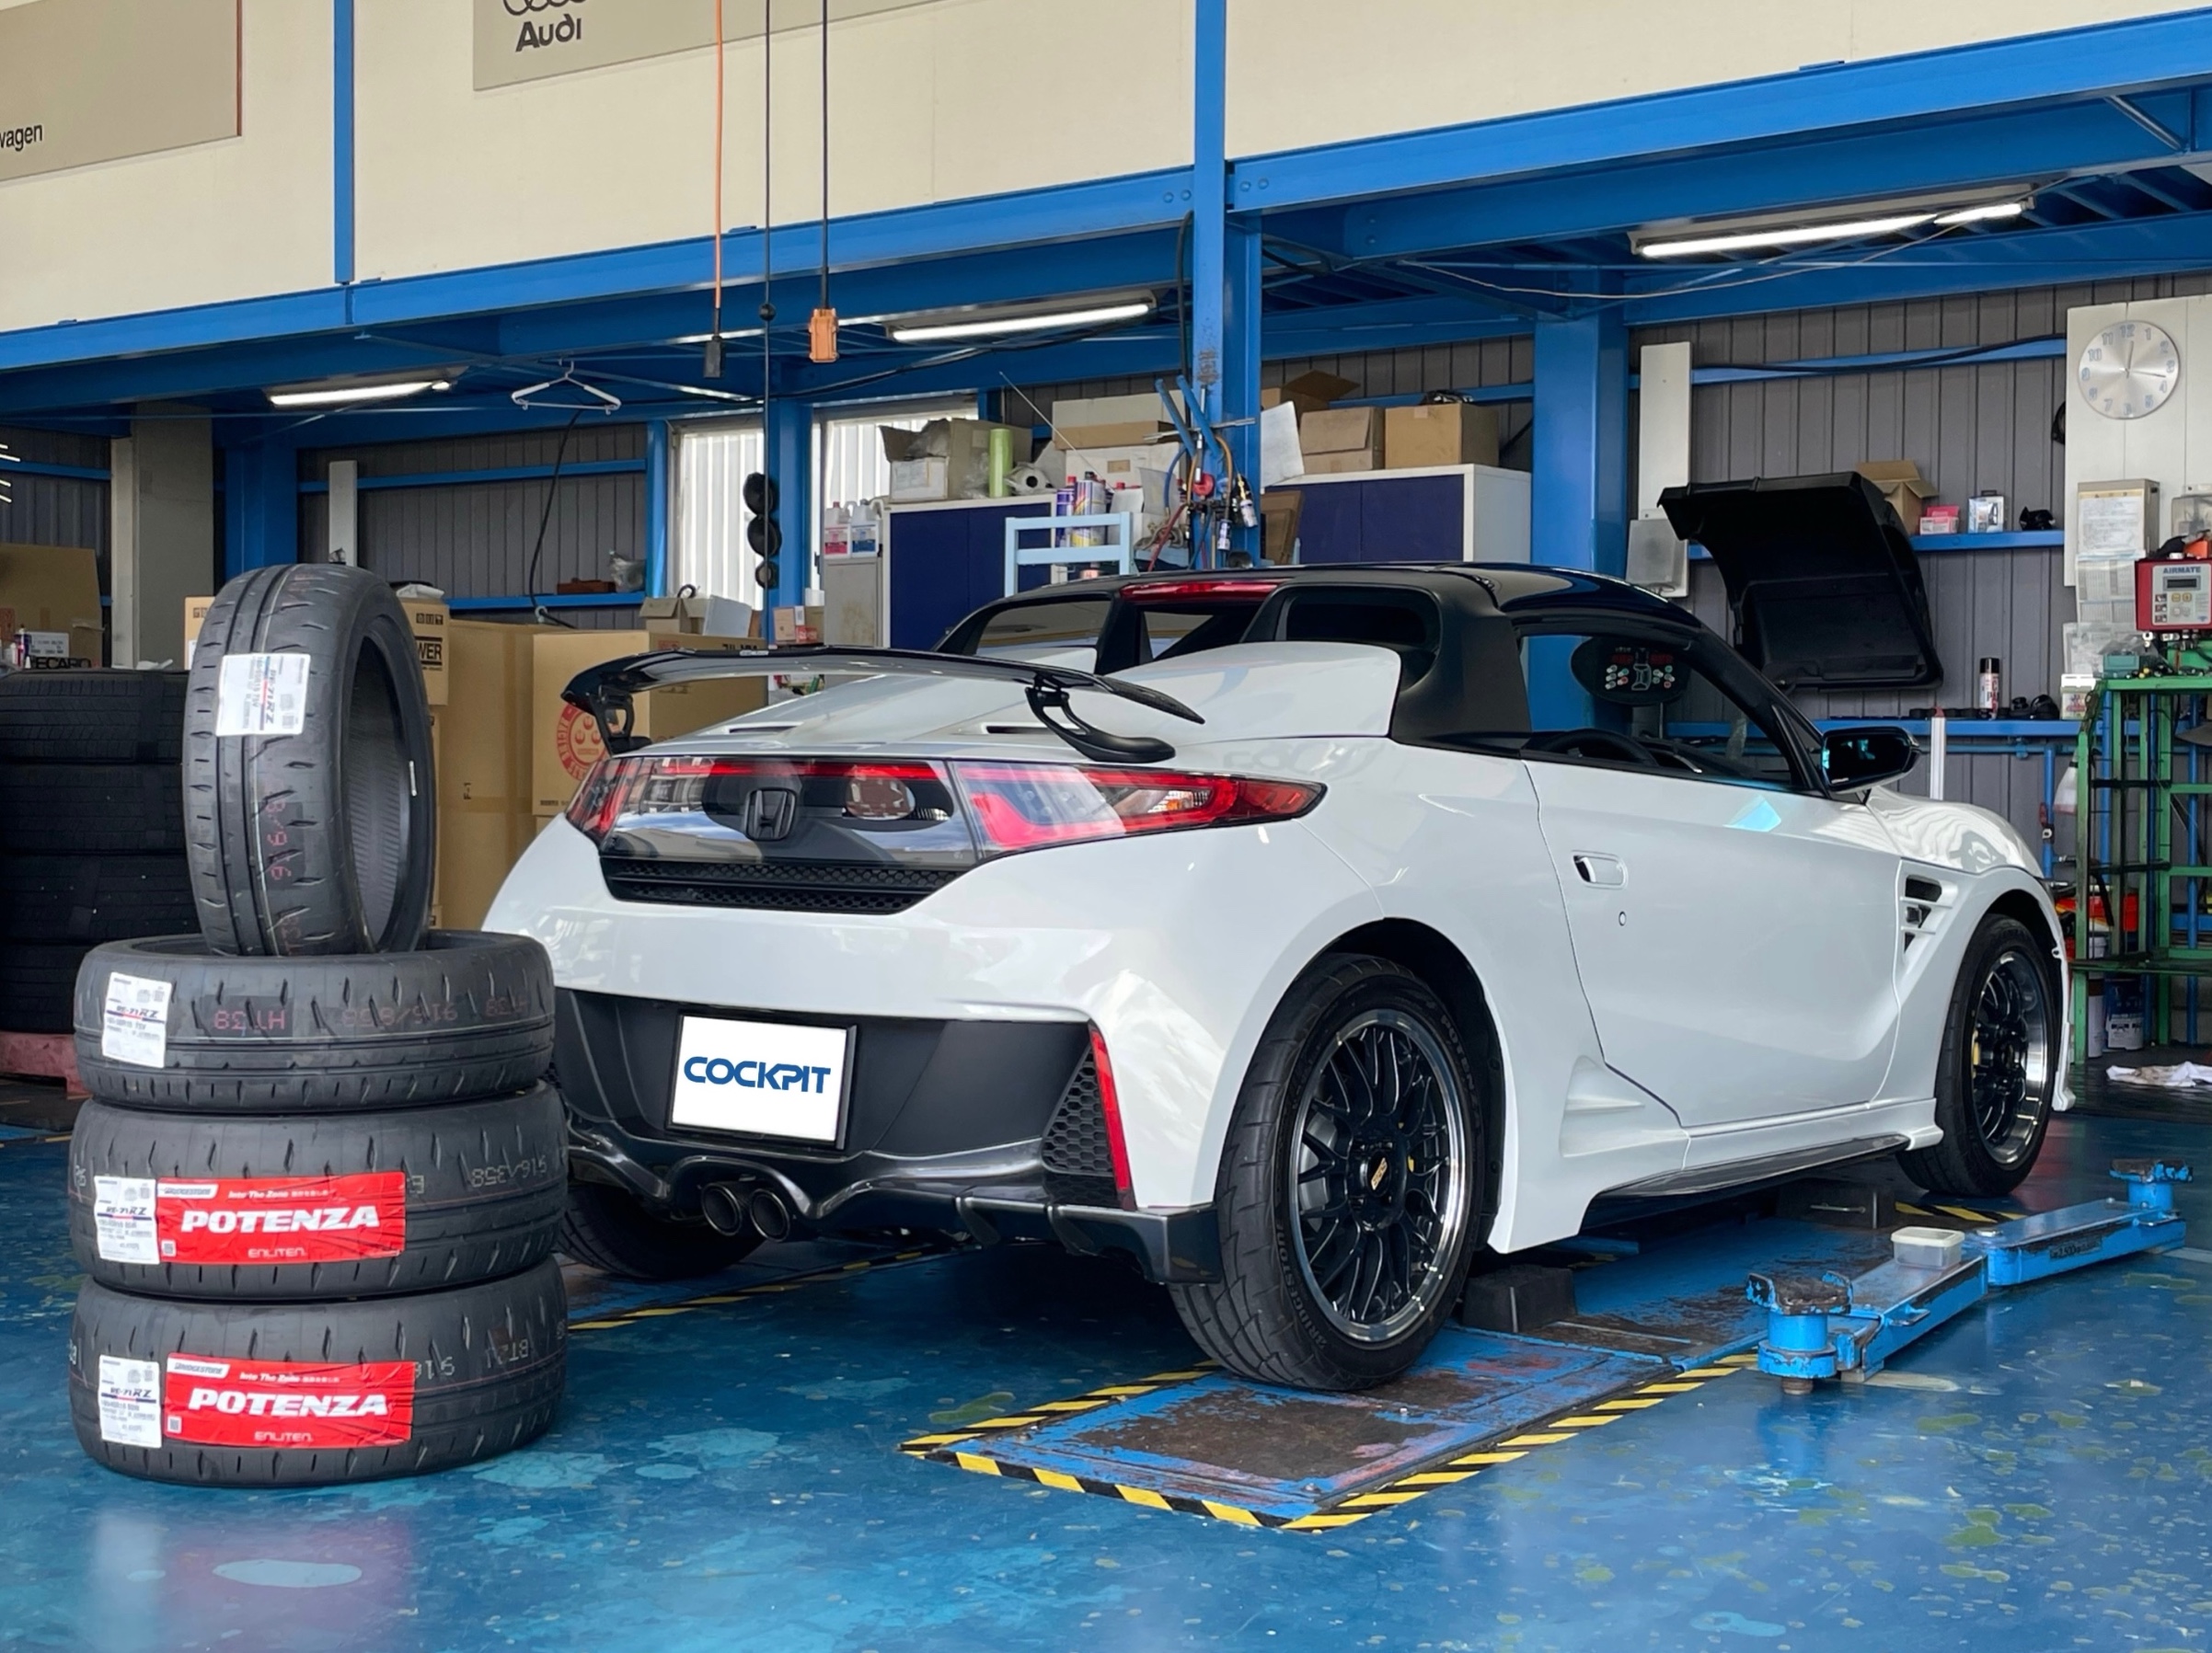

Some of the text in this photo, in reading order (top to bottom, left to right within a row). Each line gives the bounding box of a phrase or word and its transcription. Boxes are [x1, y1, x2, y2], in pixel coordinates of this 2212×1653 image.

[515, 13, 582, 52] Audi
[684, 1056, 832, 1094] COCKPIT
[180, 1205, 380, 1234] POTENZA
[173, 1361, 224, 1375] BRIDGESTONE
[188, 1387, 388, 1418] POTENZA
